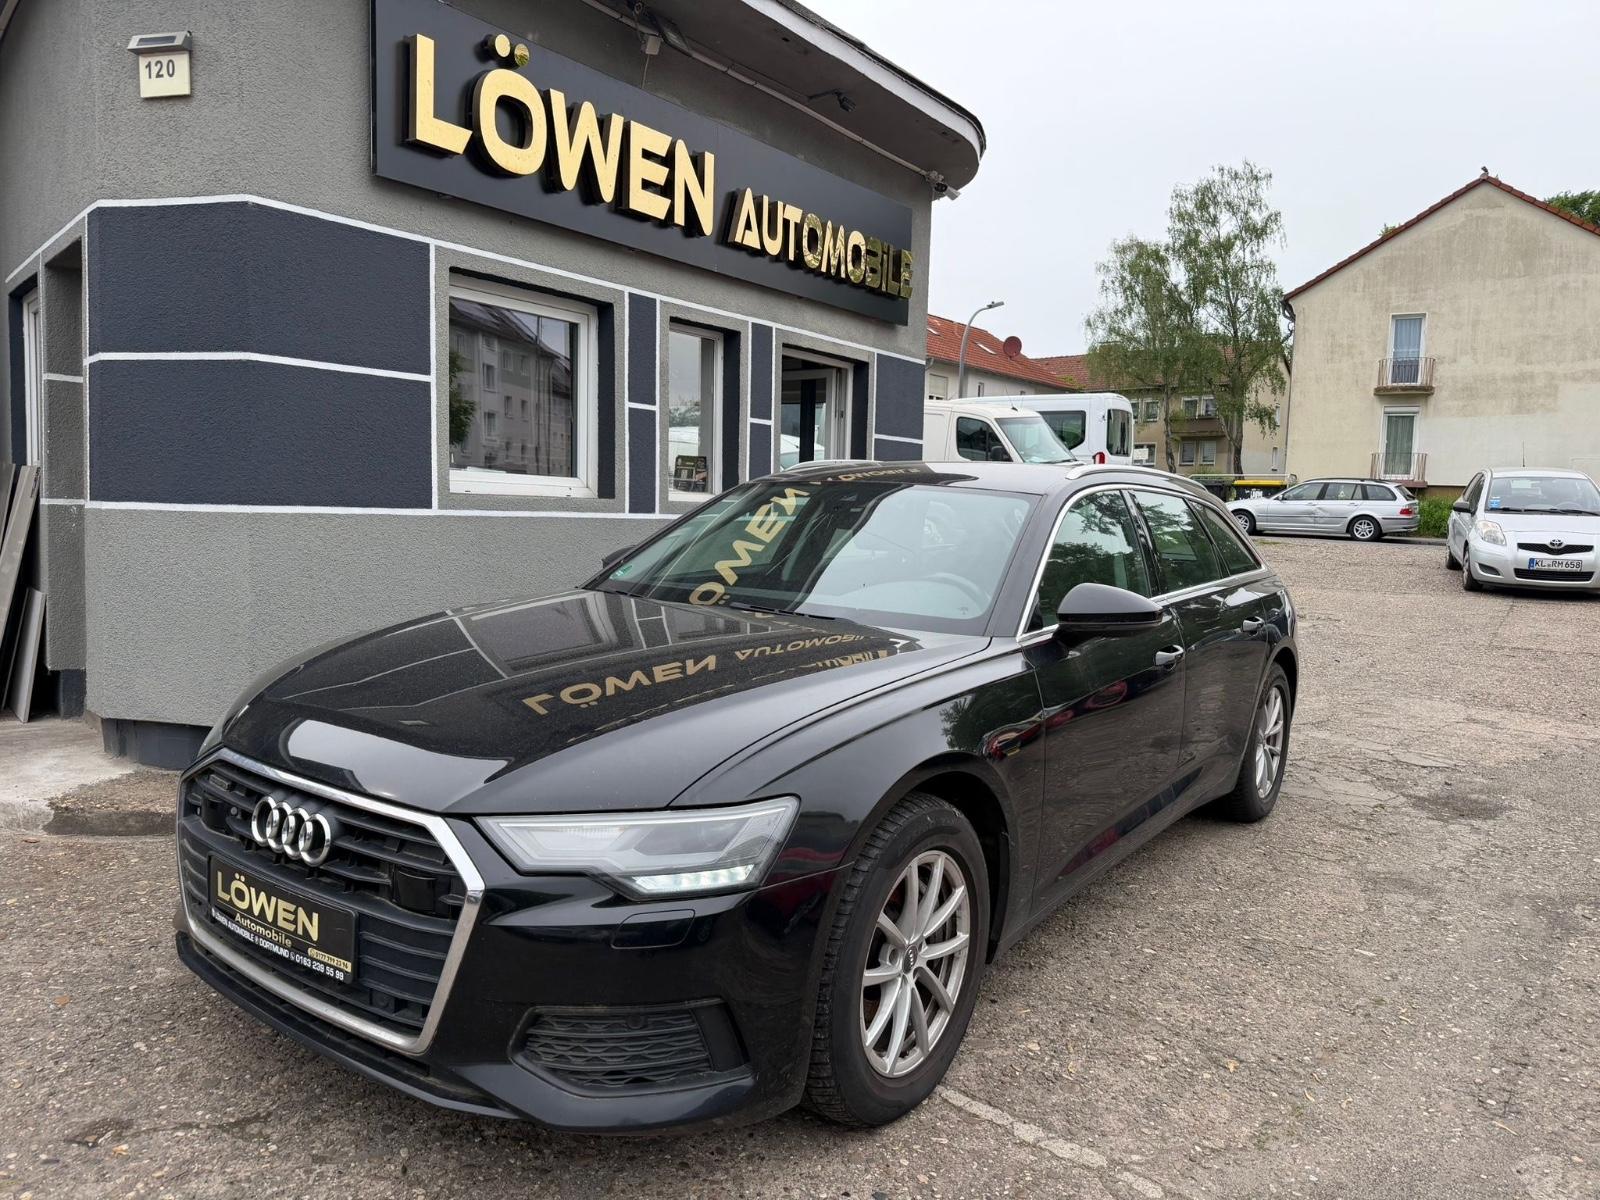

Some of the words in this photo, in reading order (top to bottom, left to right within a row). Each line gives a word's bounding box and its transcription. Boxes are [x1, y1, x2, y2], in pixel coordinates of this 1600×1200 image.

[145, 58, 176, 80] 120
[409, 33, 716, 237] LÖWEN
[731, 187, 914, 299] AUTOMOBILE
[1535, 559, 1546, 569] KL
[1551, 560, 1564, 569] RM
[1564, 561, 1581, 569] 658
[217, 870, 319, 942] LÖWEN
[234, 912, 293, 948] Automobile
[259, 937, 290, 959] DORTMUND
[295, 953, 312, 968] 0163
[312, 960, 325, 973] 239
[325, 966, 335, 977] 55
[335, 969, 344, 981] 99
